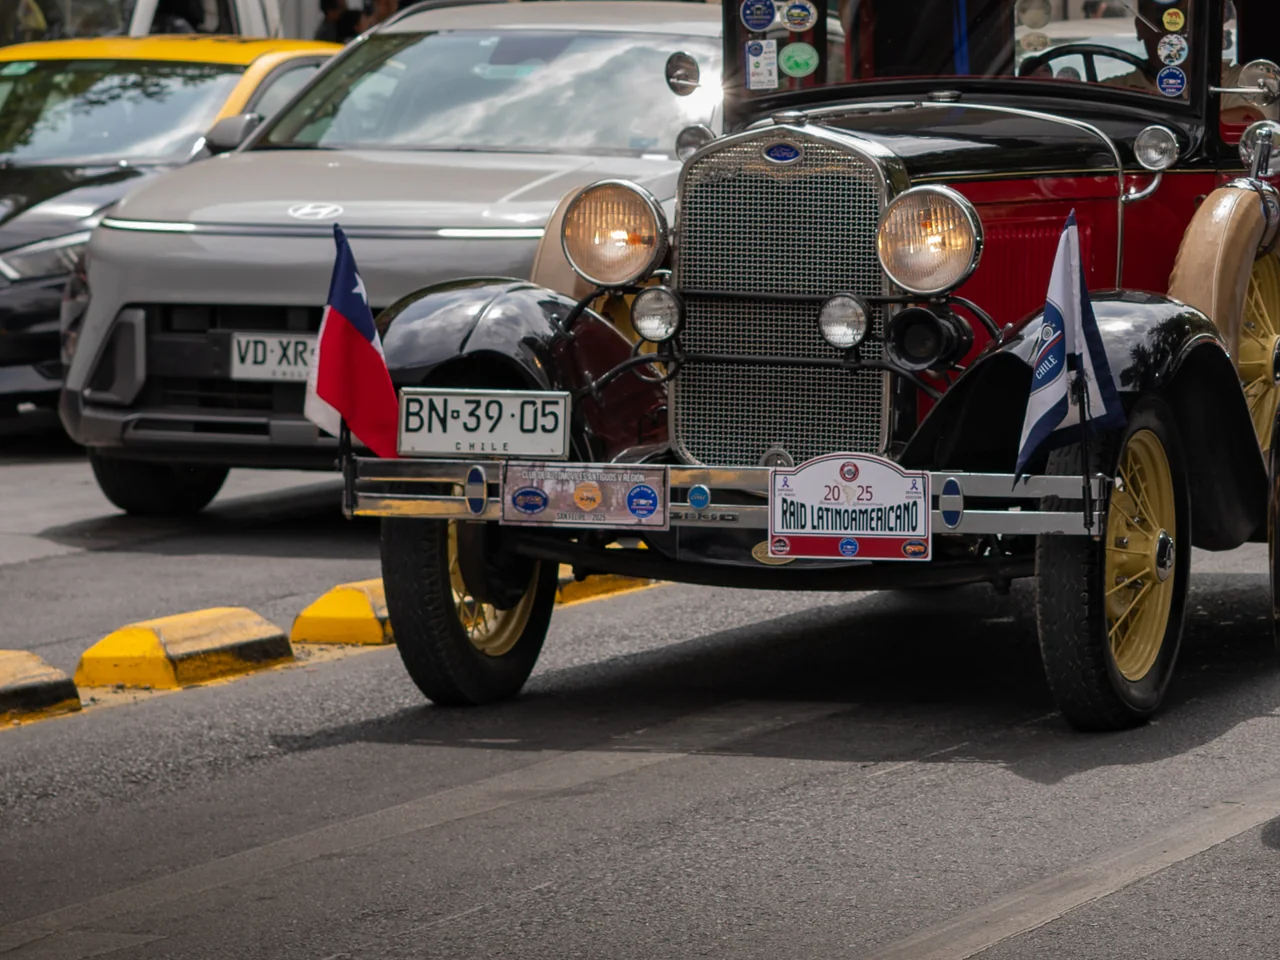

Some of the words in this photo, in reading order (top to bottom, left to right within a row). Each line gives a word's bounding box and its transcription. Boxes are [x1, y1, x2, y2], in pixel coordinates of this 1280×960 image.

[1035, 354, 1058, 380] CHILE
[455, 442, 509, 451] CHILE
[824, 485, 840, 501] 20
[857, 485, 873, 501] 25
[781, 496, 807, 530] RAID
[811, 500, 918, 533] LATINOAMERICANO
